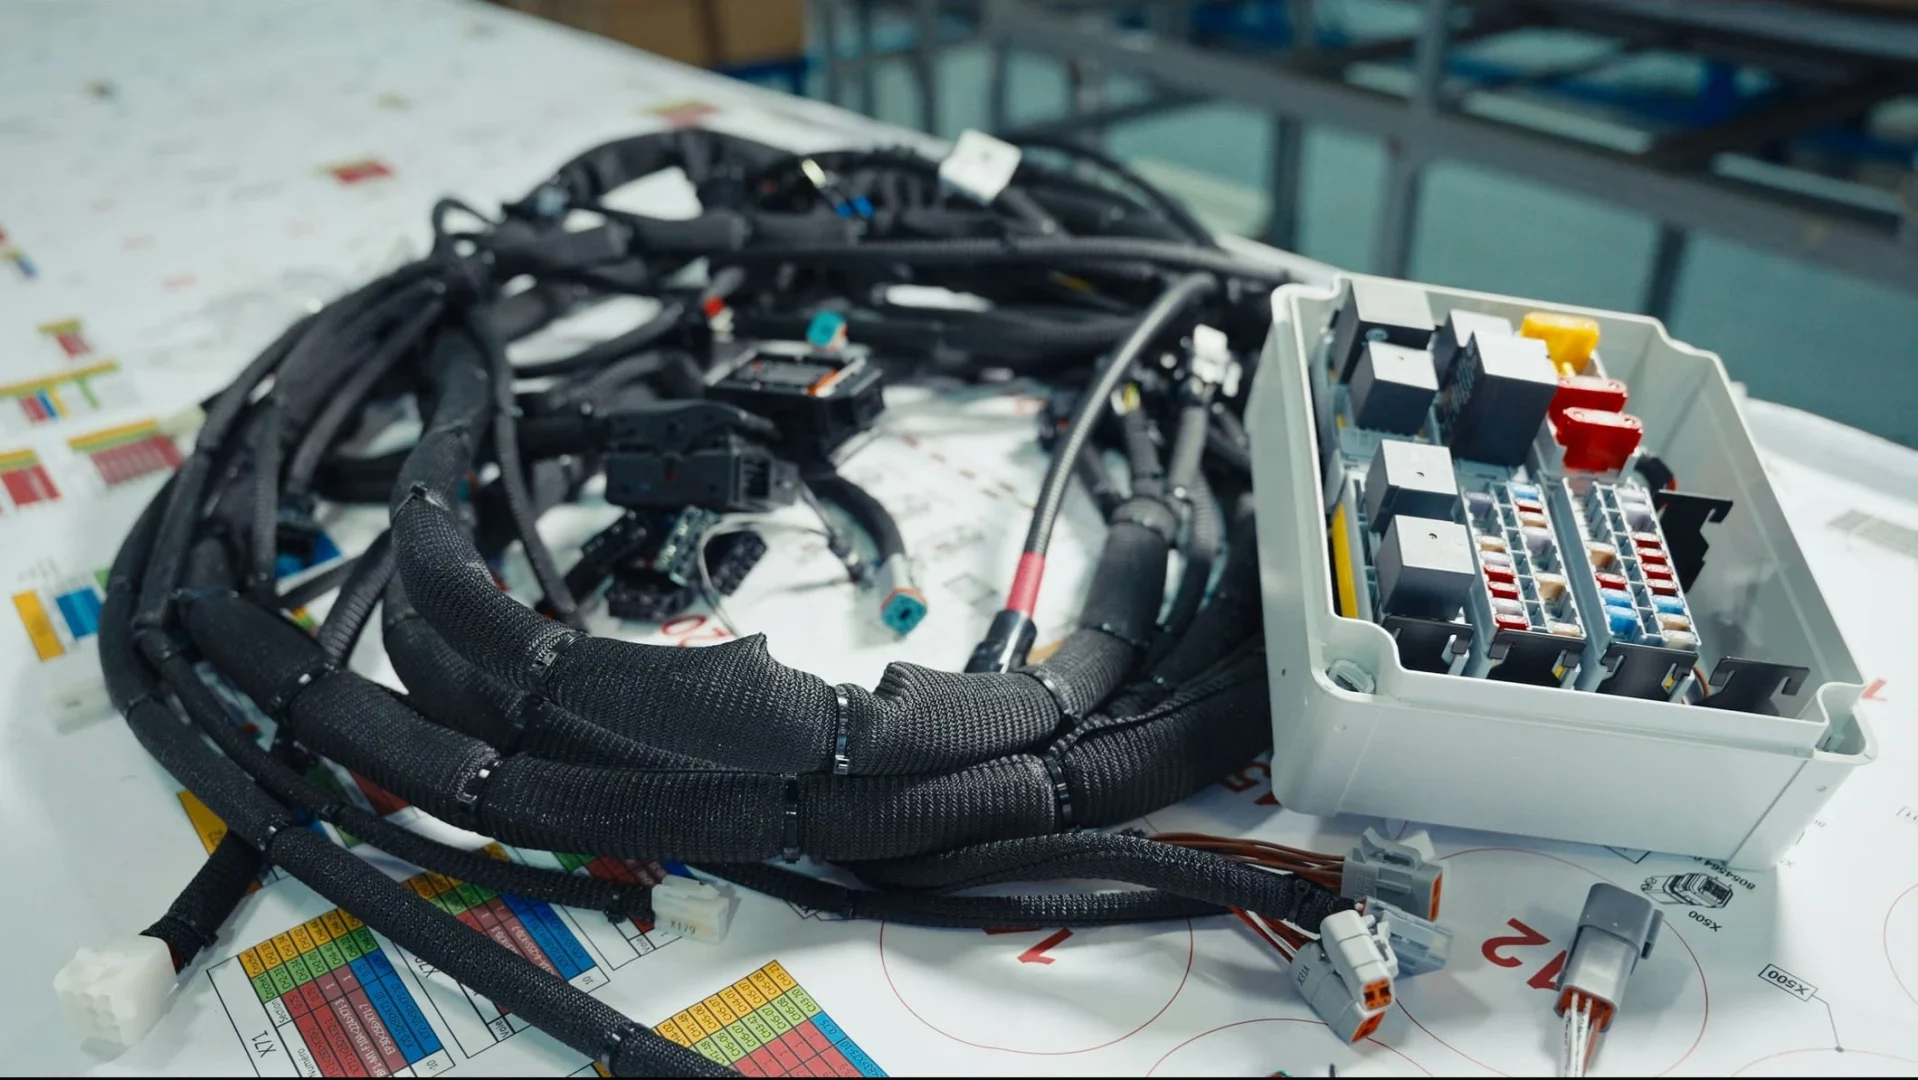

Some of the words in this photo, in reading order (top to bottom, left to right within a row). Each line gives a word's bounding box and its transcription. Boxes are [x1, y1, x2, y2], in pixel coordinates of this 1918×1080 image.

[670, 919, 696, 935] X179
[1688, 910, 1722, 932] X500
[635, 936, 650, 953] Voie
[1481, 919, 1567, 992] 12
[242, 949, 263, 976] Crochet
[289, 958, 309, 982] CH2-34
[306, 951, 325, 975] CH2-01
[768, 962, 792, 989] CH3-21
[255, 974, 276, 1001] Crochet
[272, 966, 291, 991] CH2-33
[325, 981, 336, 991] 1
[582, 974, 593, 986] 10
[753, 970, 778, 998] CH5-08
[1766, 969, 1810, 995] X500
[724, 988, 748, 1015] CH4-01
[738, 979, 762, 1007] CH5-07
[791, 986, 817, 1015] CH3-20
[268, 1001, 288, 1025] Section
[693, 1003, 717, 1032] CH5-06
[708, 995, 733, 1023] CH5-07
[761, 1004, 788, 1033] CH5-07
[777, 995, 802, 1024] CH5-08
[491, 1020, 511, 1040] Voie
[678, 1011, 702, 1040] CH1-48
[731, 1021, 756, 1050] CH5-07
[747, 1013, 772, 1041] CH3-42
[251, 1030, 276, 1058] X71
[701, 1038, 725, 1067] CH1-48
[716, 1030, 742, 1059] CH5-06
[296, 1048, 318, 1078] Numéro
